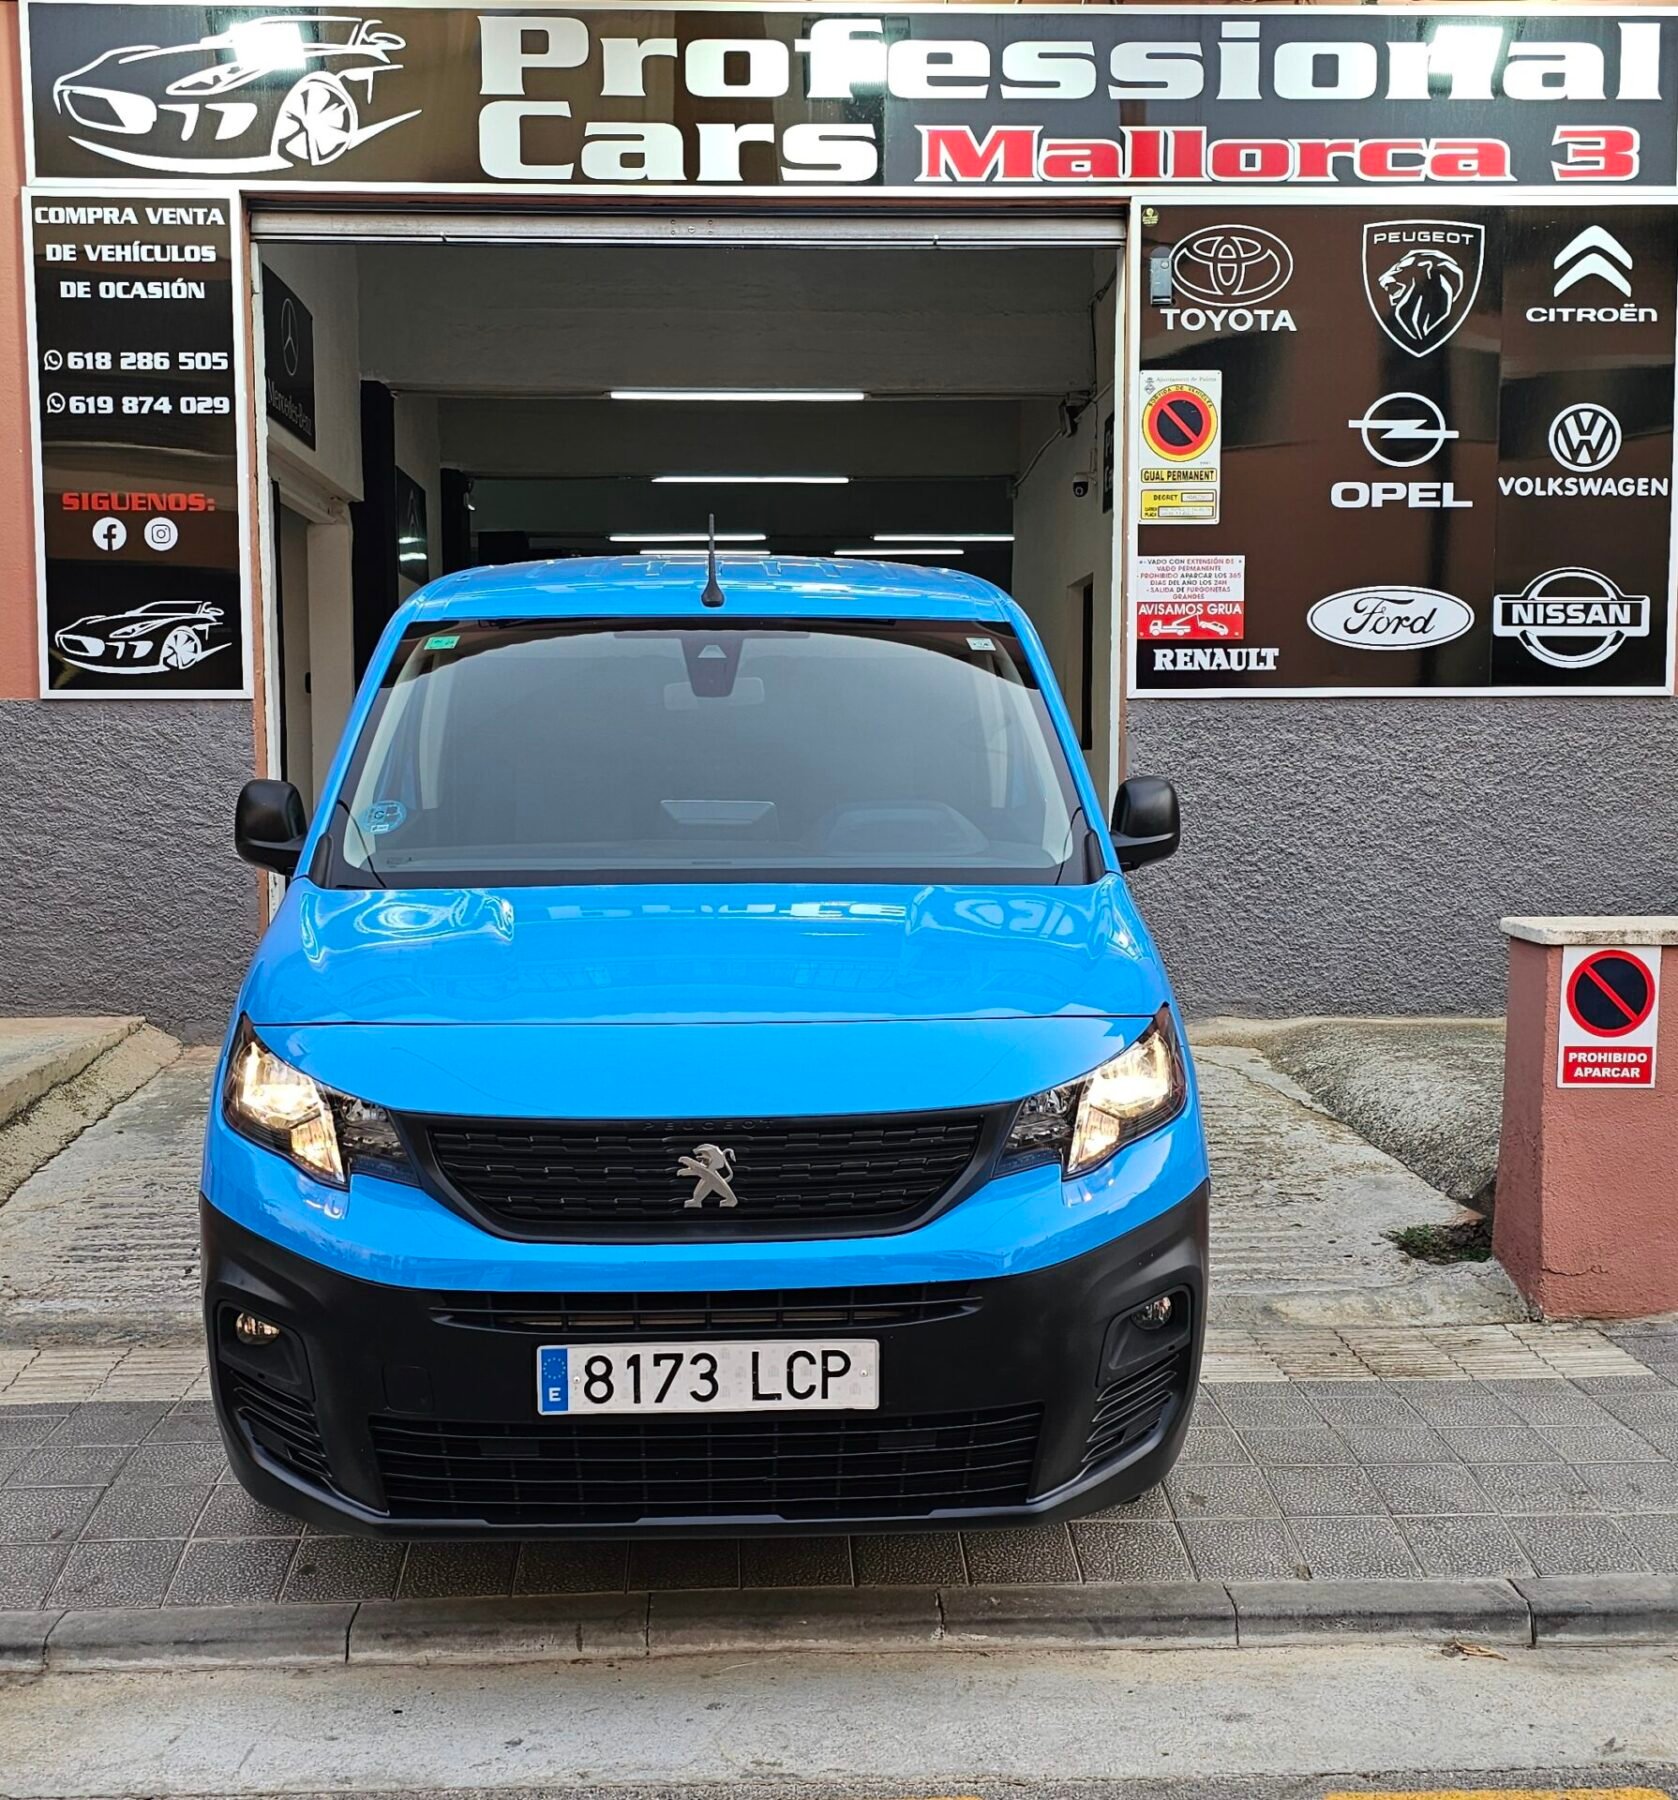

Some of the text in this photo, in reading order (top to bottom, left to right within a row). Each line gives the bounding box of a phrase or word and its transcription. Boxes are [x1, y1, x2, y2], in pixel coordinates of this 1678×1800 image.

[478, 15, 1661, 101] Professional
[478, 99, 1640, 183] Cars Mallorca 3
[34, 206, 226, 226] COMPRA VENTA
[1373, 231, 1474, 246] PEUGEOT
[45, 240, 216, 263] DE VEHÍCULOS
[59, 277, 206, 299] DE OCASIÓN
[1160, 308, 1297, 332] TOYOTA
[67, 351, 229, 371] 618 286 505
[69, 396, 230, 415] 619 874 029
[1143, 470, 1215, 481] GUAL PERMANENT
[1330, 482, 1473, 508] OPEL
[1498, 477, 1669, 497] VOLKSWAGEN
[62, 493, 216, 512] SIGUENOS:
[1138, 603, 1243, 616] AVISAMOS GRUA
[1343, 596, 1438, 636] Ford
[1511, 603, 1632, 625] NISSAN
[1153, 647, 1280, 671] RENAULT
[1568, 1052, 1648, 1064] PROHIBIDO
[1573, 1067, 1641, 1079] APARCAR
[583, 1349, 852, 1405] 8173 LCP
[548, 1387, 562, 1402] E
